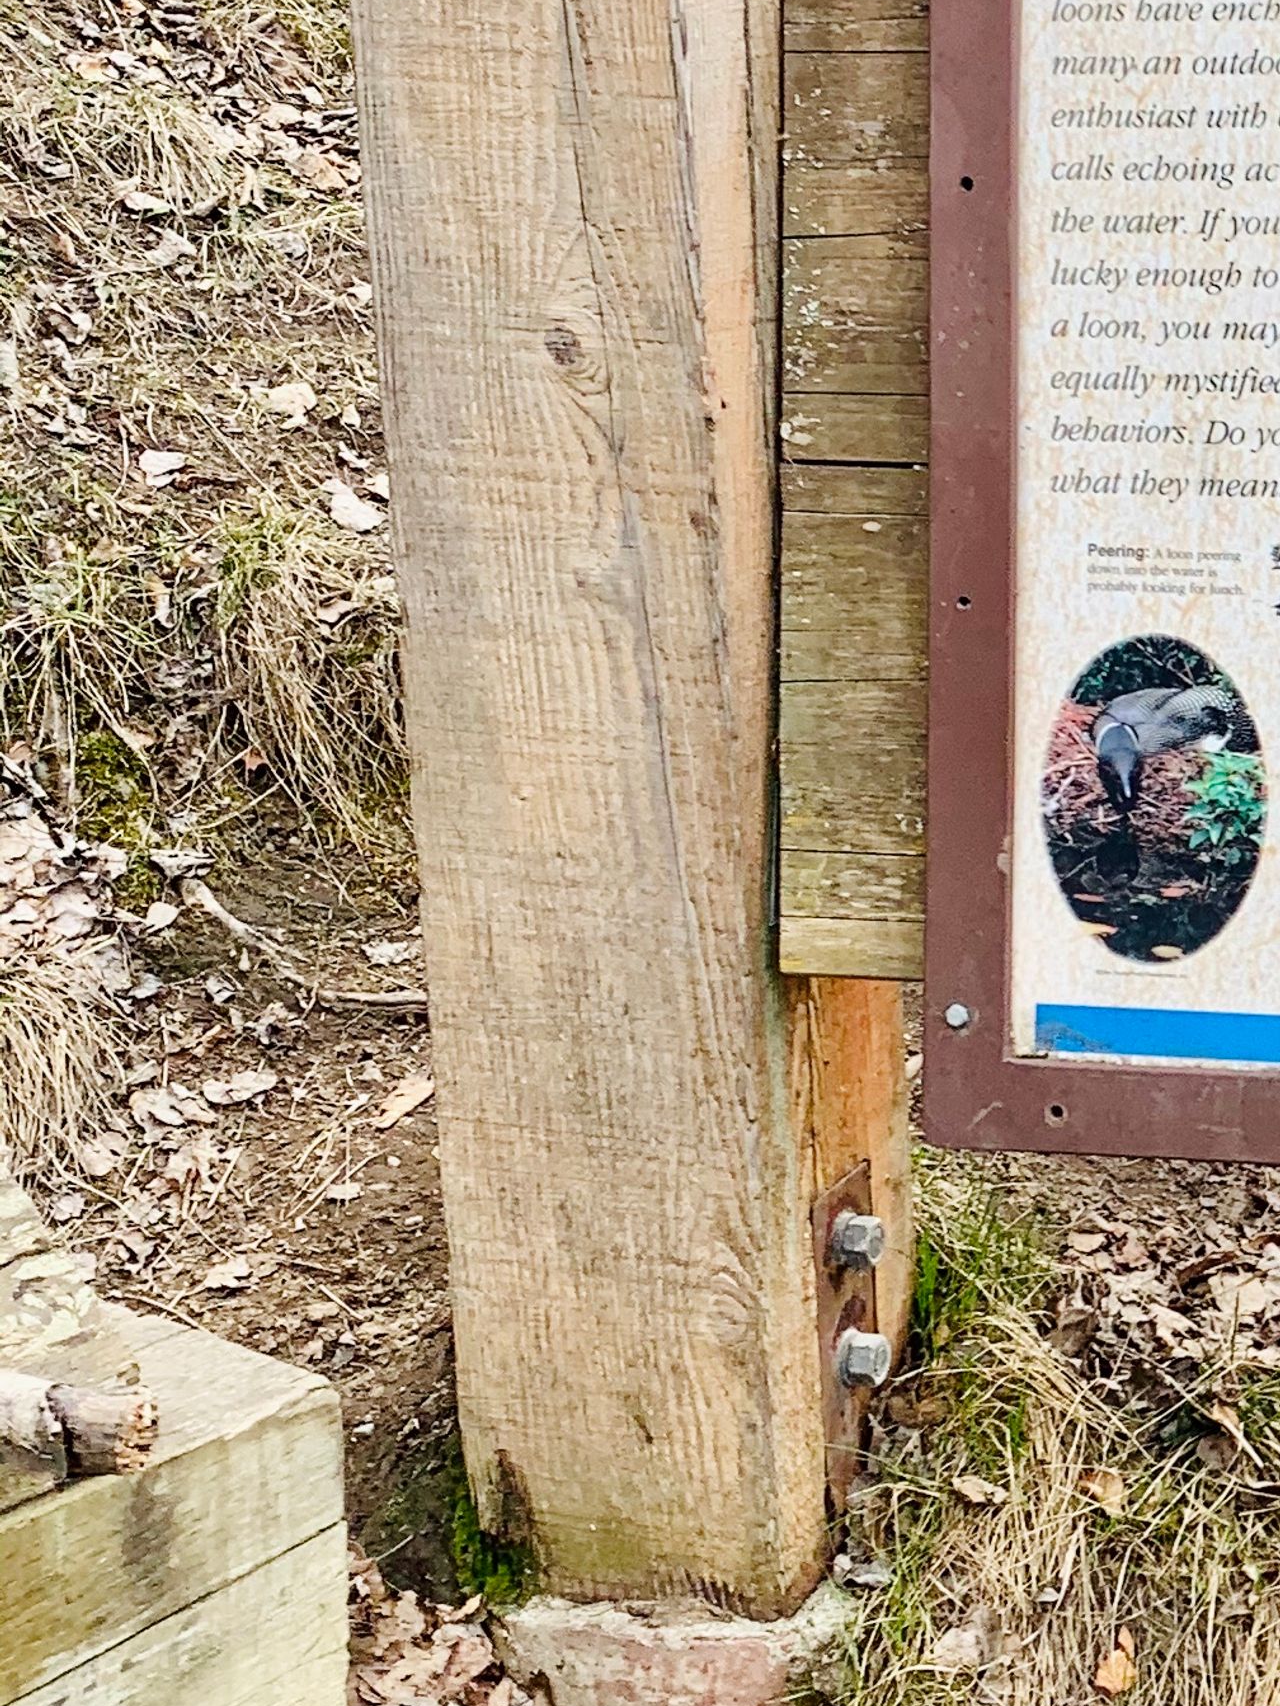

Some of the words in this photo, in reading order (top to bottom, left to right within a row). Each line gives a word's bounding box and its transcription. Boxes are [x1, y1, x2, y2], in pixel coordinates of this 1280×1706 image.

[1053, 56, 1136, 82] many
[1143, 56, 1181, 75] an
[1052, 104, 1195, 129] enthusiast
[1207, 102, 1266, 128] with
[1052, 155, 1113, 182] calls
[1123, 157, 1235, 188] echoing
[1052, 207, 1094, 234] the
[1104, 213, 1188, 234] water.
[1200, 210, 1224, 241] If
[1051, 260, 1127, 292] lucky
[1137, 262, 1241, 293] enough
[1253, 265, 1278, 289] to
[1051, 321, 1068, 338] a
[1079, 313, 1146, 342] loon,
[1157, 322, 1210, 345] you
[1051, 365, 1155, 397] equally
[1051, 416, 1194, 444] behaviors.
[1206, 420, 1245, 446] Do
[1051, 468, 1120, 493] what
[1131, 469, 1188, 502] they
[1088, 544, 1150, 560] Peering:
